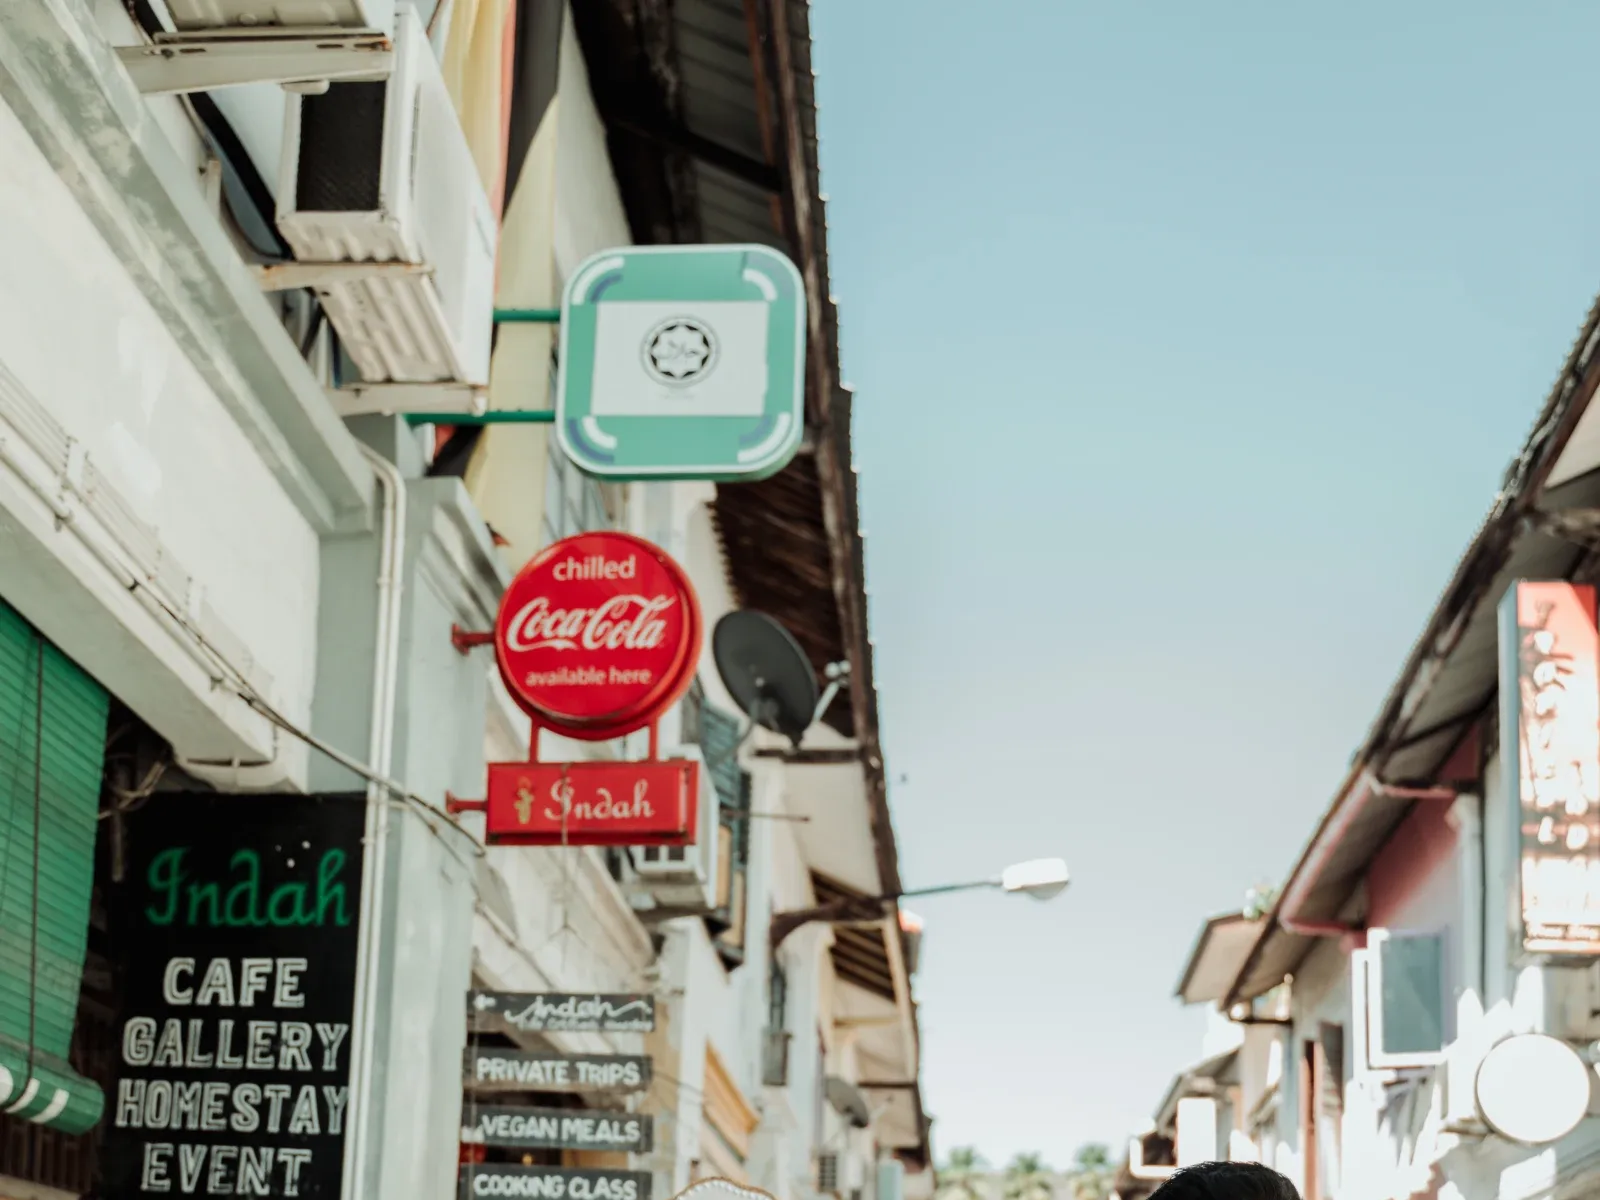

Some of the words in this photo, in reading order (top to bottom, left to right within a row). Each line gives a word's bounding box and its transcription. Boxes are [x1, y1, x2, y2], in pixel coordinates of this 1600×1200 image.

[552, 555, 636, 581] chilled
[526, 667, 605, 687] available
[608, 665, 652, 685] here
[544, 776, 655, 820] Indah
[145, 847, 351, 927] Indah
[163, 957, 308, 1008] CAFE
[122, 1016, 350, 1071] GALLERY
[476, 1057, 569, 1085] PRIVATE
[576, 1061, 641, 1087] TRIPS
[115, 1077, 350, 1135] HOMESTAY
[482, 1115, 558, 1140] VEGAN
[561, 1119, 641, 1144] MEALS
[140, 1142, 312, 1197] EVENT
[473, 1173, 565, 1198] COOKING
